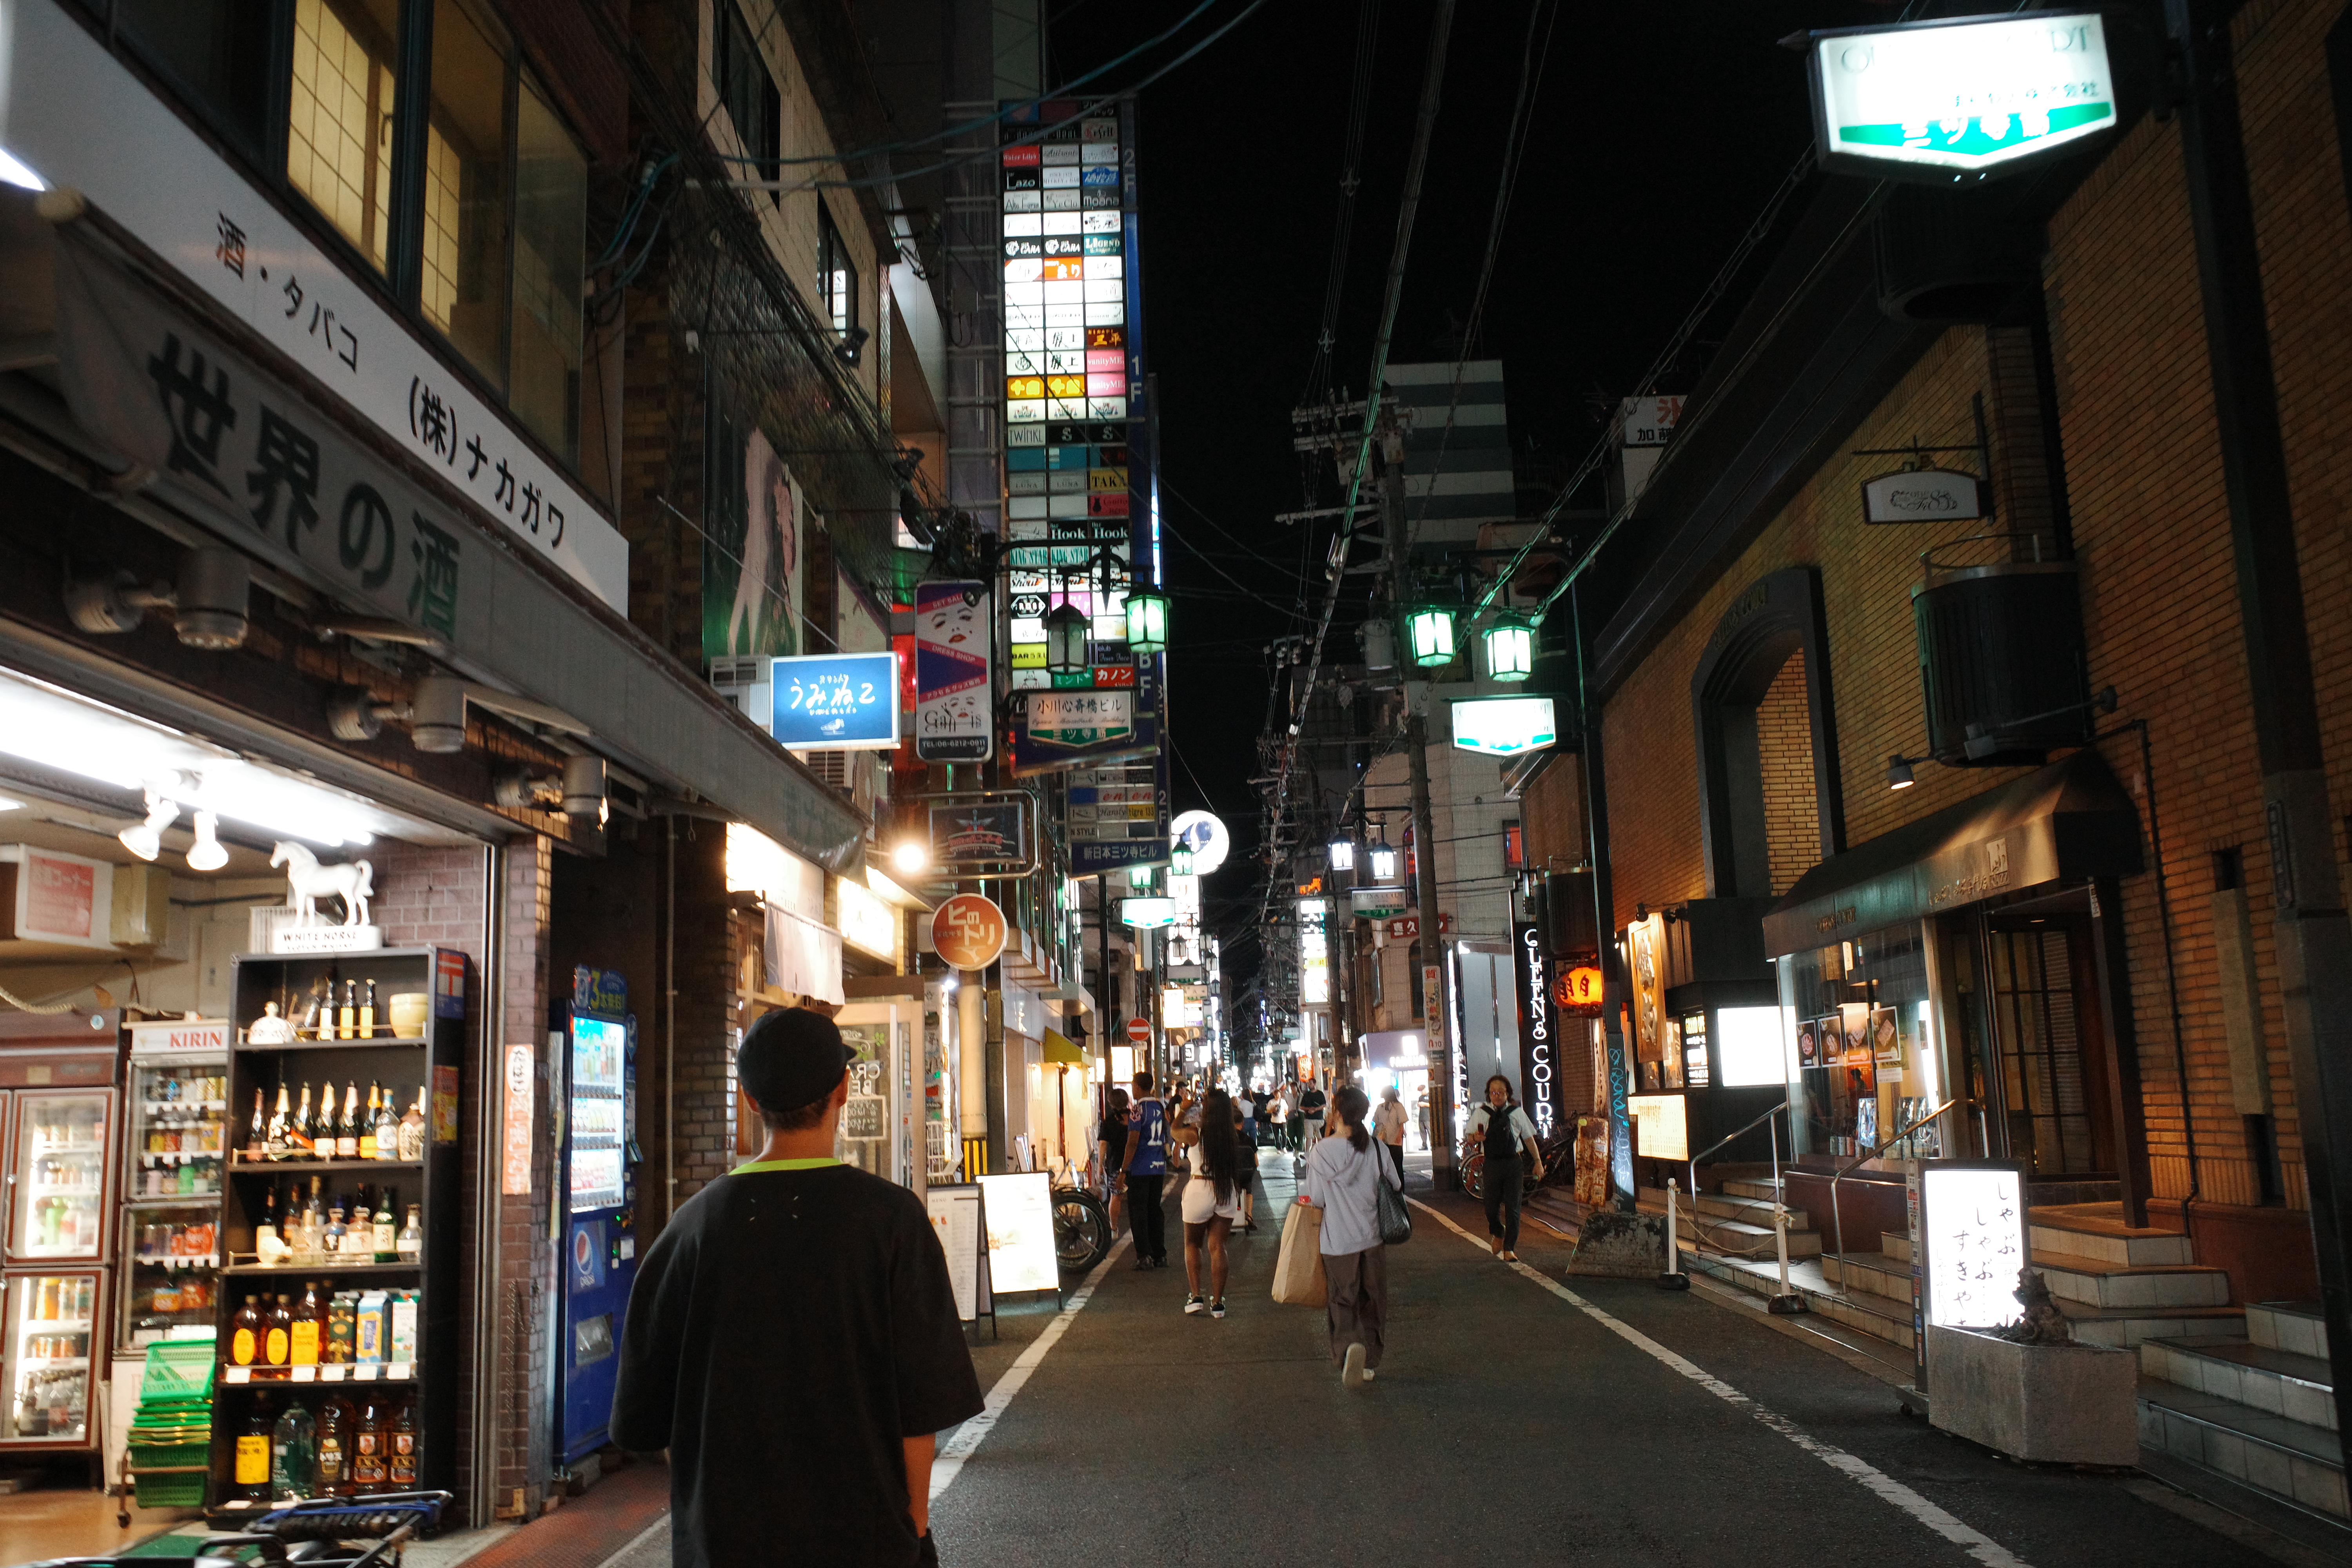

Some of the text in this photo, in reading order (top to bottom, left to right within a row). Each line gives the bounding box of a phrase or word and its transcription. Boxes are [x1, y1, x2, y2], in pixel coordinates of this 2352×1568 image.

[216, 210, 358, 374] 酒・タバコ
[410, 375, 565, 549] (株)ナカガワ
[148, 331, 461, 642] 世界の酒
[1051, 528, 1086, 540] Hook
[1094, 527, 1129, 539] Hook
[1097, 669, 1131, 682] カノン
[1083, 845, 1157, 860] 新日本三ツ寺ビル
[170, 1031, 223, 1047] KIRIN
[1147, 1119, 1163, 1147] 11
